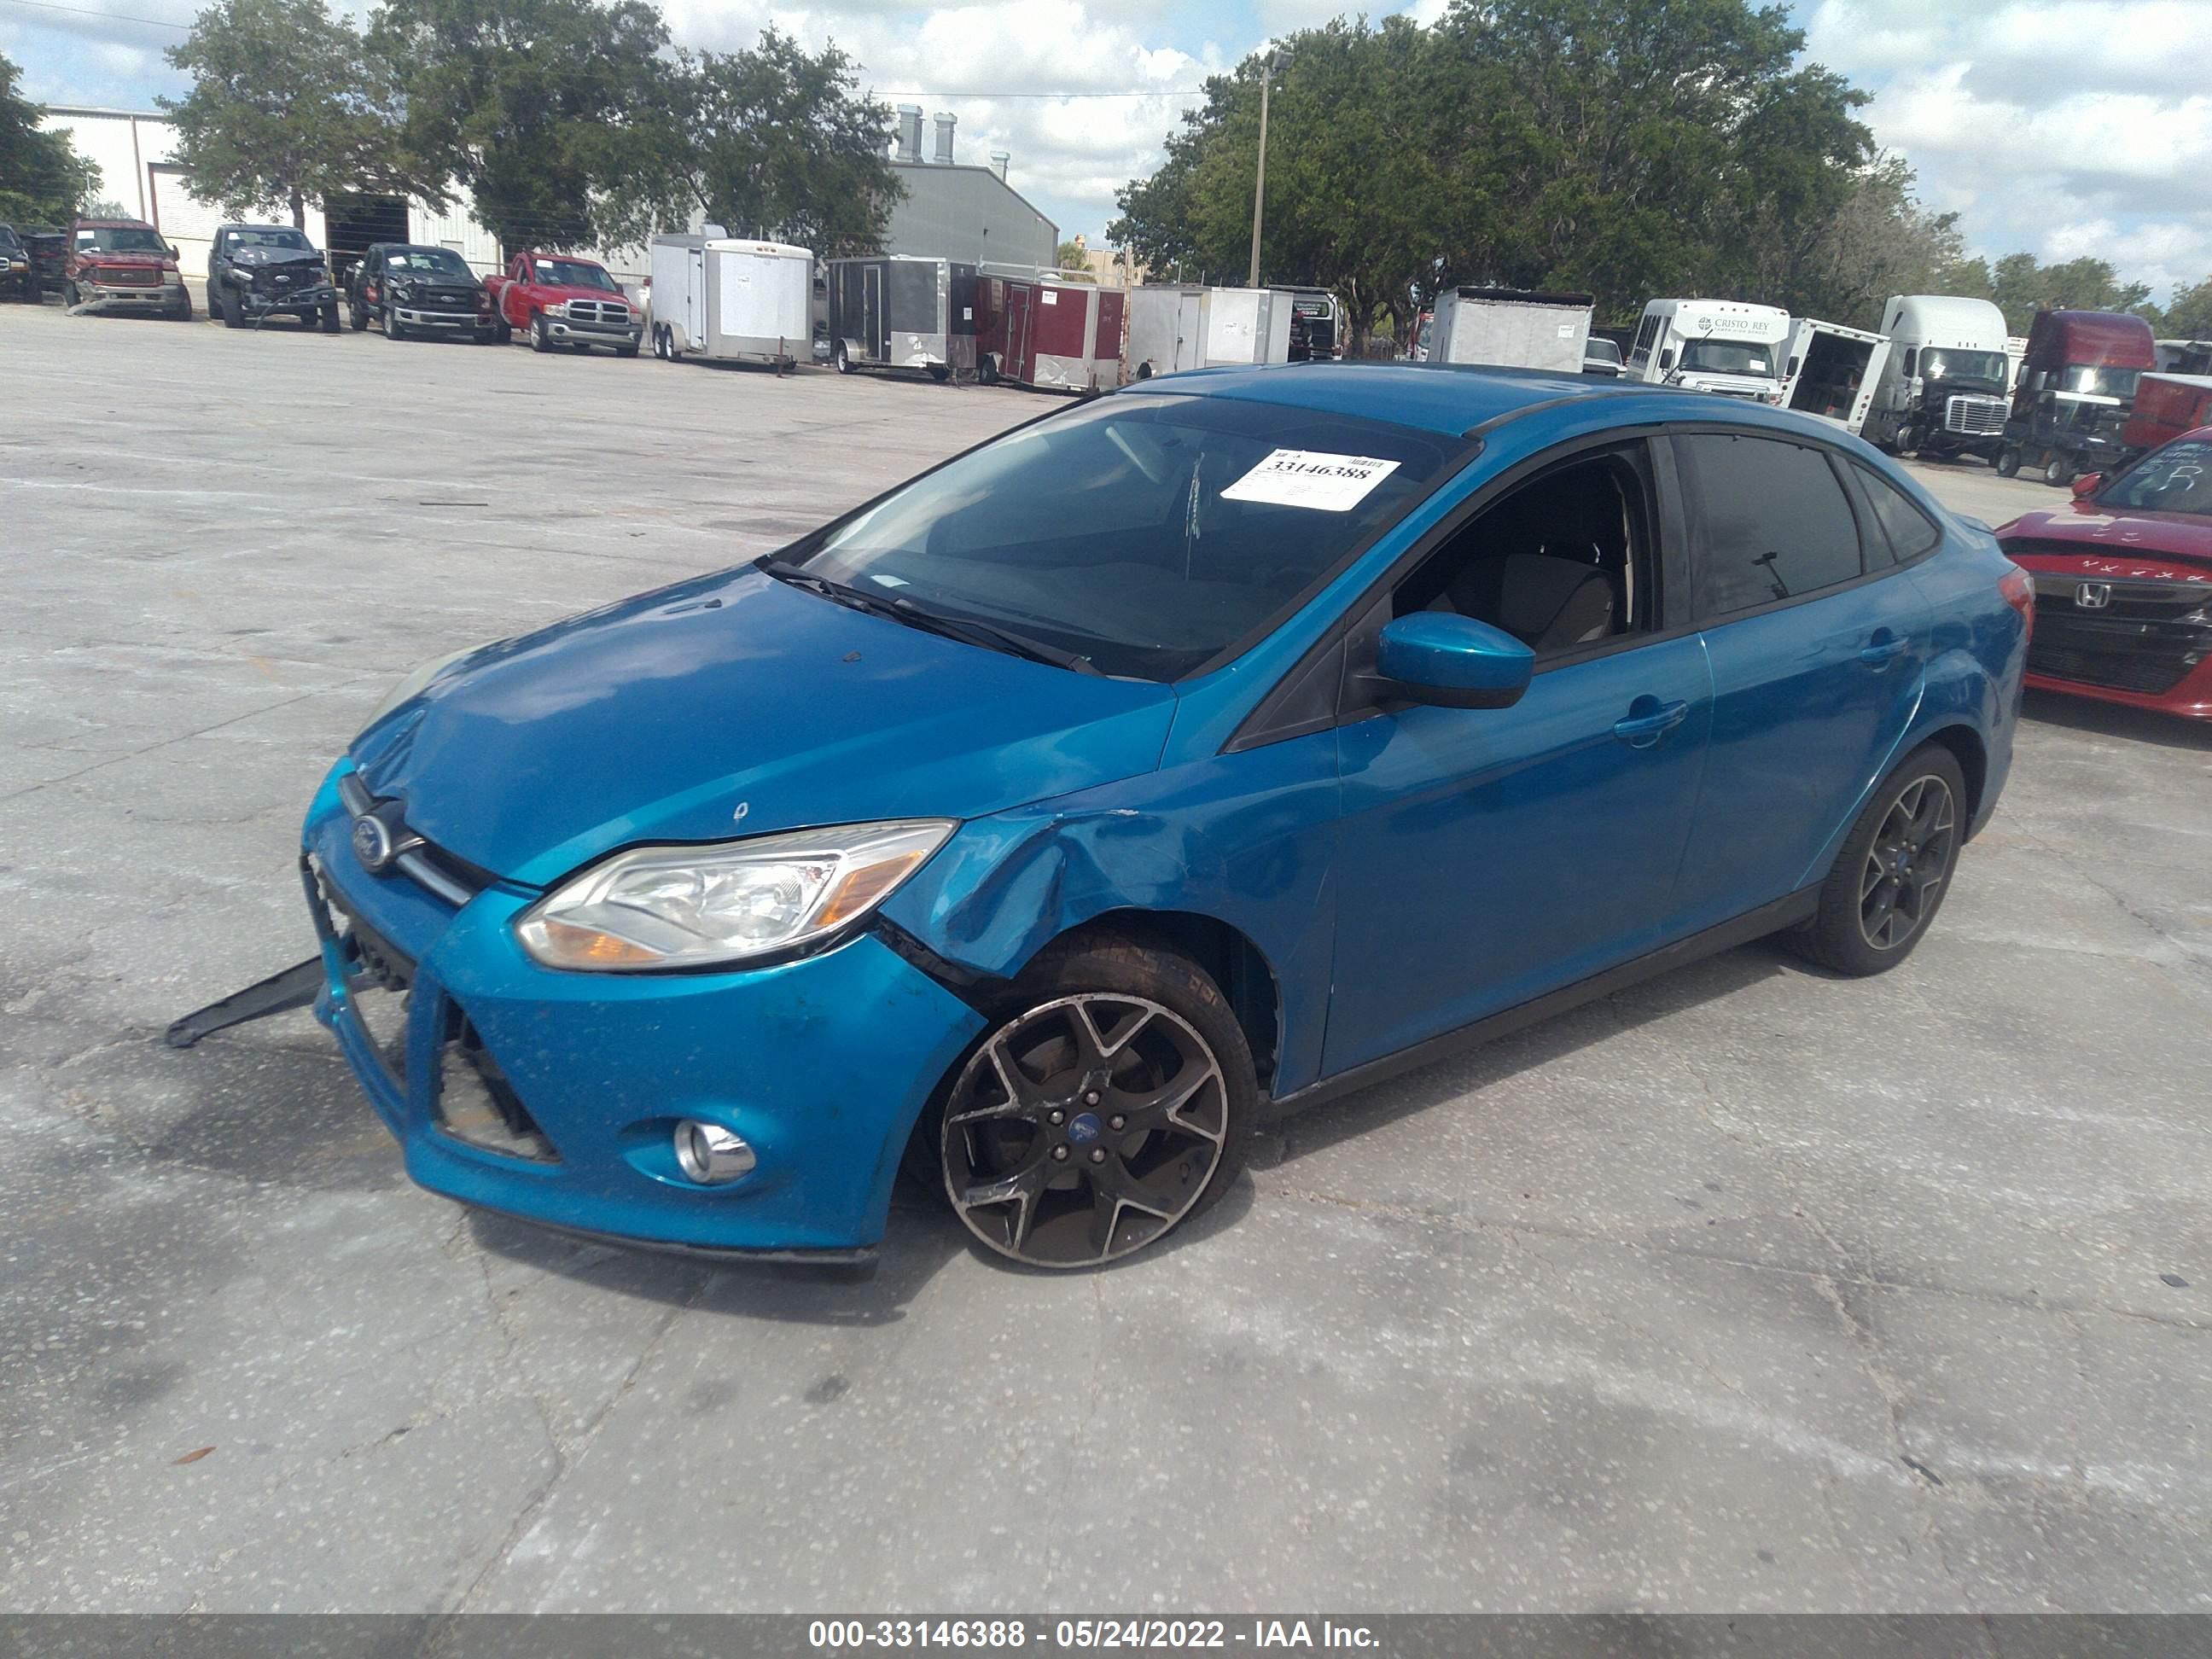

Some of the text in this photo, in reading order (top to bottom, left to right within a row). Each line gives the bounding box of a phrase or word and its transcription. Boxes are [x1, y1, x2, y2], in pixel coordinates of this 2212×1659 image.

[1715, 318, 1769, 330] CRISTO REY
[1266, 461, 1371, 480] 33146388
